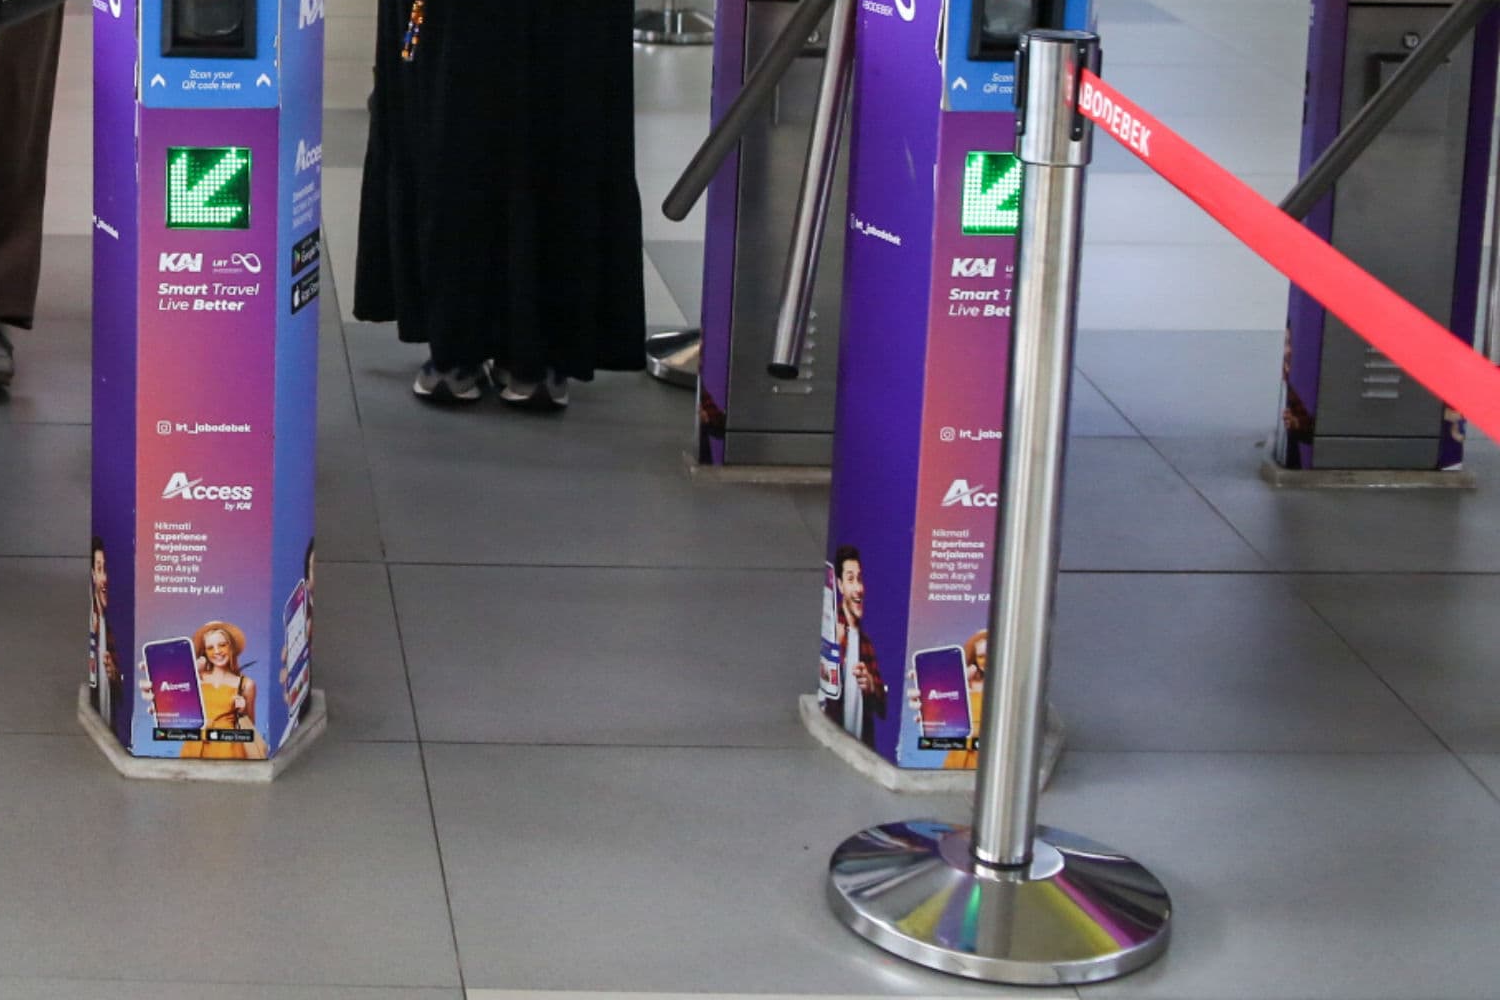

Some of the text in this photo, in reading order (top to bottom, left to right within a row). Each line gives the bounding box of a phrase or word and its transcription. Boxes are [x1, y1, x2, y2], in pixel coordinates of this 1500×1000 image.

[189, 69, 234, 83] Scan your
[182, 80, 241, 91] QR code here
[983, 83, 998, 94] QR
[158, 252, 203, 272] KAI
[951, 258, 997, 277] KAI
[157, 282, 260, 295] Smart Travel
[948, 287, 999, 301] Smart
[158, 298, 245, 311] Live Better
[948, 303, 1011, 316] Live Bet
[175, 422, 251, 434] lrt_jabodebek
[959, 429, 1003, 441] lrt_jabo
[161, 471, 253, 500] Access
[941, 479, 998, 507] Acc
[236, 502, 252, 511] KAI
[154, 521, 191, 531] Nikmati
[154, 542, 207, 553] Perjalanan
[154, 585, 189, 593] Access
[189, 585, 203, 596] by
